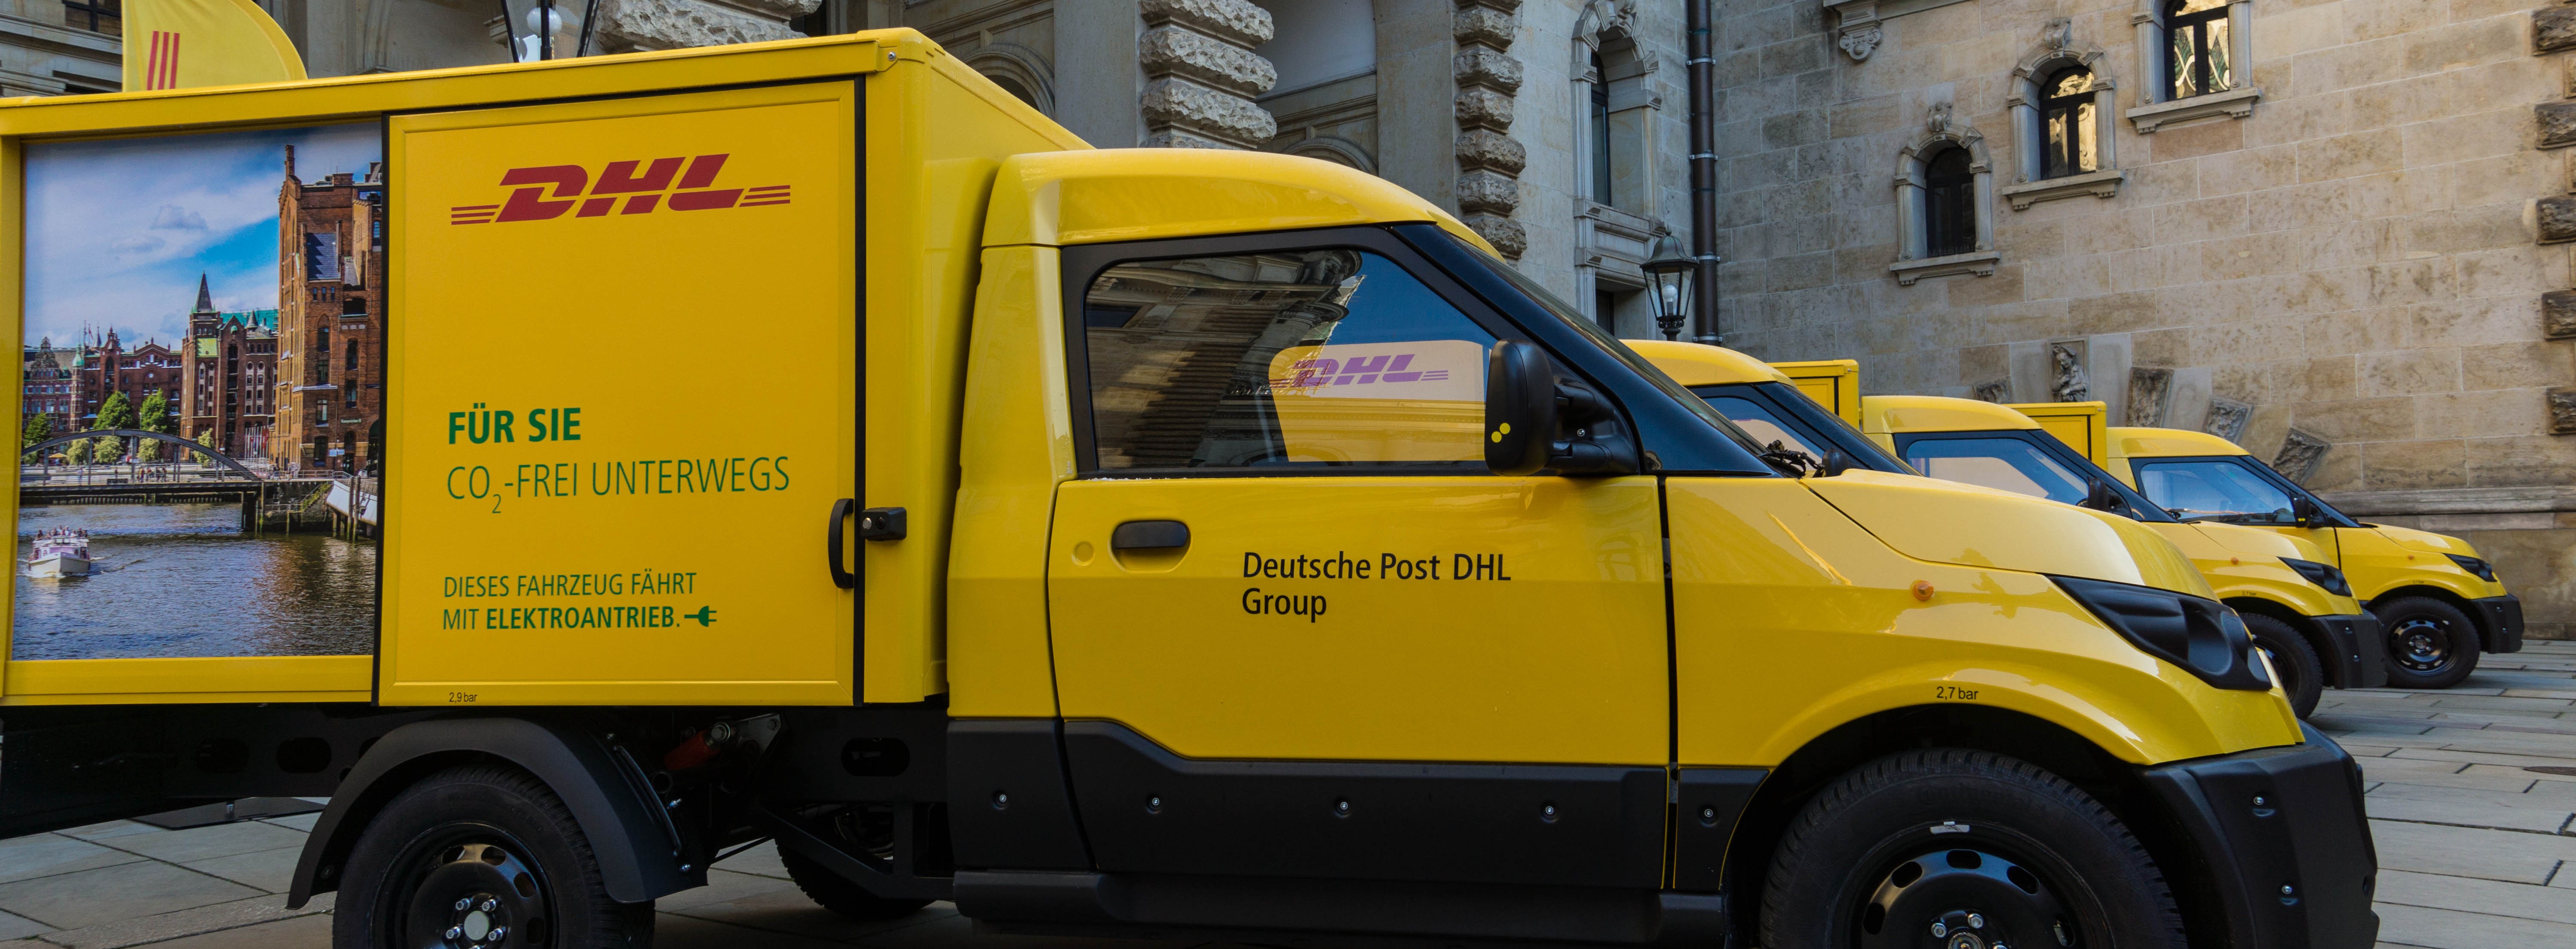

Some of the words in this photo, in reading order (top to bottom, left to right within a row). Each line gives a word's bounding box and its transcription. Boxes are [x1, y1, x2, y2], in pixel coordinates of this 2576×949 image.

[494, 153, 745, 223] DHL
[1290, 353, 1424, 387] DHL
[448, 402, 515, 445] FÜR
[528, 407, 581, 442] SIE
[592, 456, 790, 496] UNTERWEGS
[1243, 551, 1371, 579] Deutsche
[1380, 553, 1441, 581] Post
[1453, 553, 1512, 581] DHL
[444, 576, 510, 598] DIESES
[517, 573, 623, 597] FAHRZEUG
[631, 568, 697, 595] FÄHRT
[443, 609, 480, 630] MIT
[486, 606, 680, 630] ELEKTROANTRIEB.
[1242, 588, 1327, 624] Group
[449, 692, 462, 704] 2,9
[464, 692, 478, 702] bar
[1936, 686, 1956, 700] 2,7
[1958, 687, 1979, 700] bar
